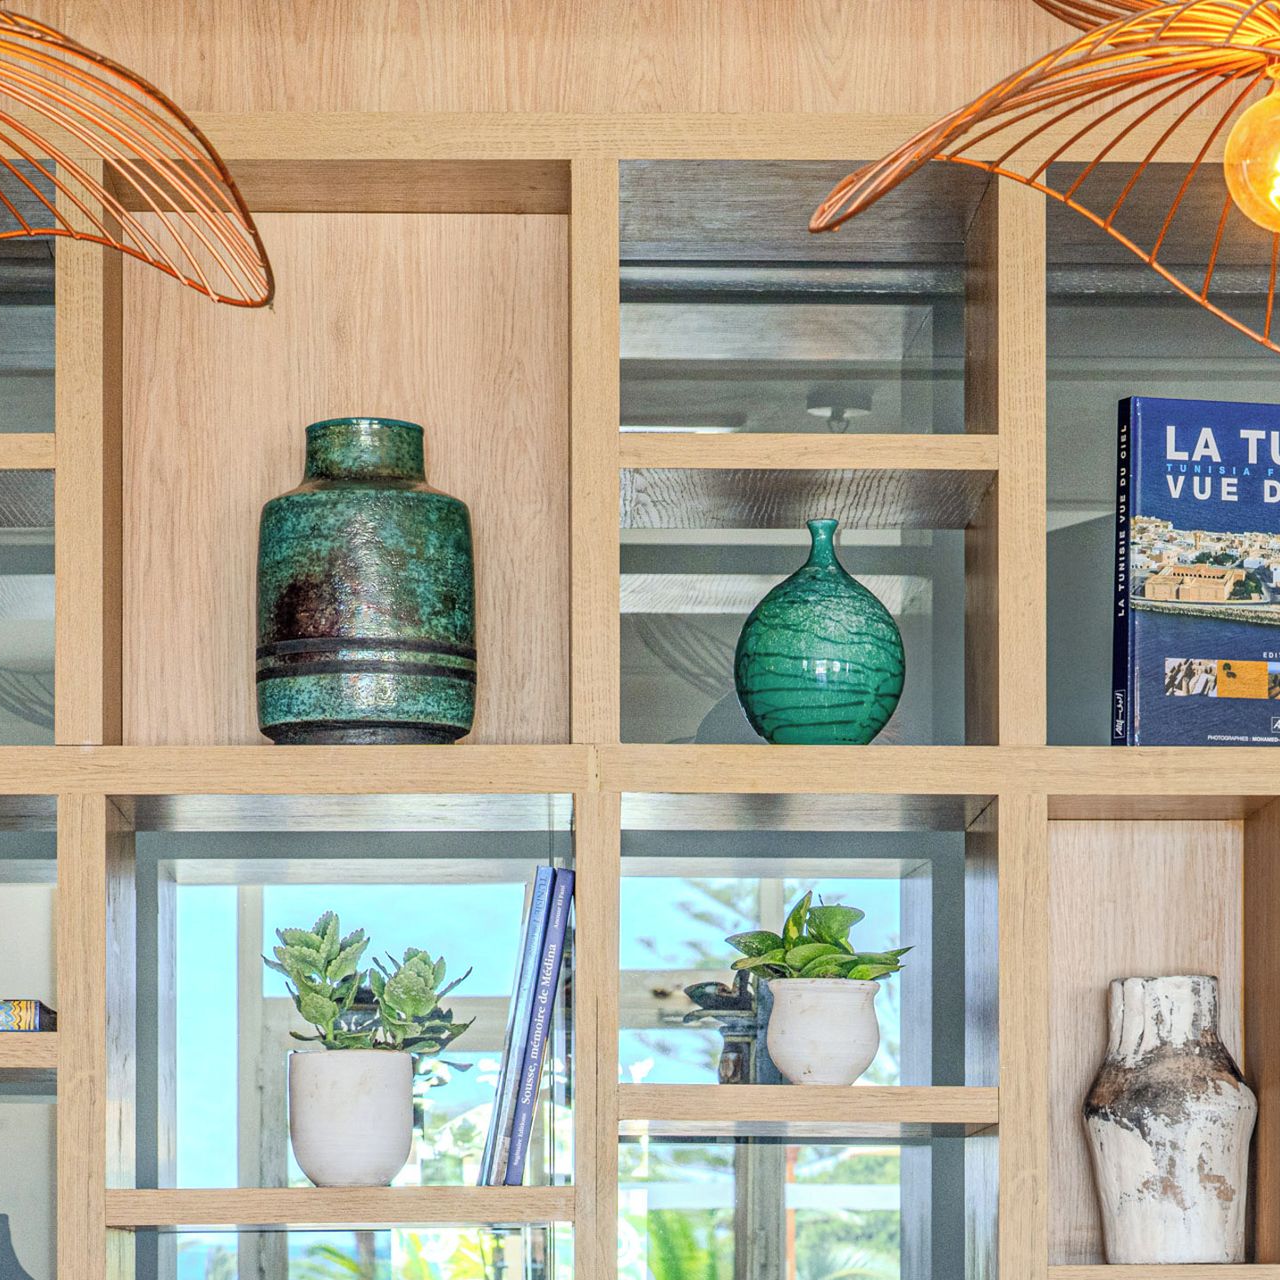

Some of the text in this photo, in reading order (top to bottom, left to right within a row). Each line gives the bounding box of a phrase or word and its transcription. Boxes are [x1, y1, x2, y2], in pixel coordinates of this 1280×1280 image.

[1166, 425, 1221, 463] LA
[1120, 467, 1126, 487] DU
[1166, 463, 1251, 476] TUNISIA
[1166, 475, 1239, 502] VUE
[1118, 599, 1125, 617] LA
[522, 943, 557, 1105] Sousse, mémoire de Médina
